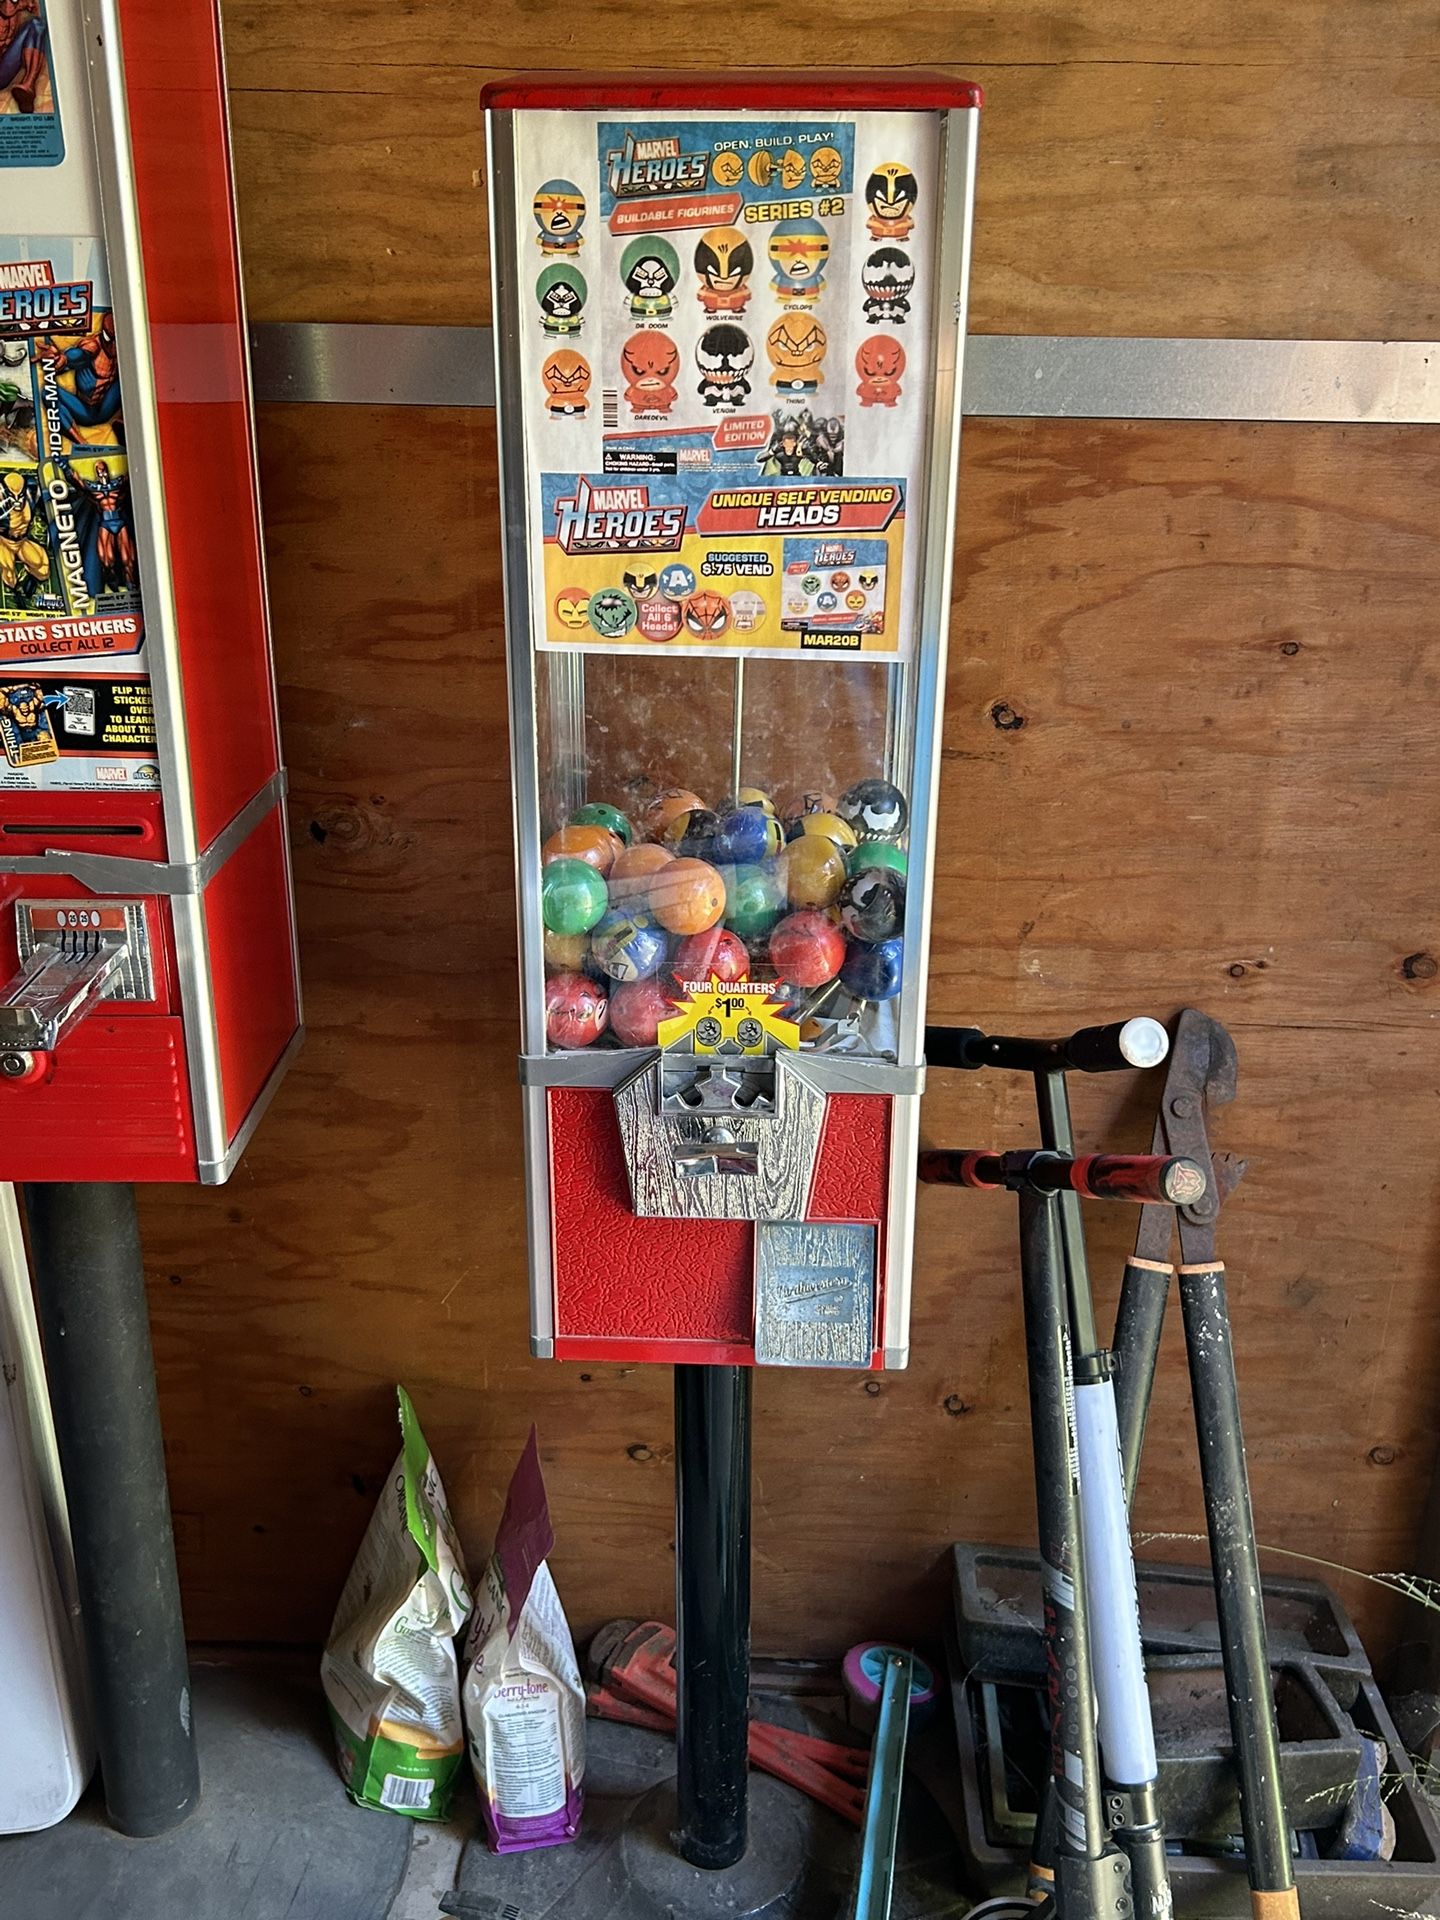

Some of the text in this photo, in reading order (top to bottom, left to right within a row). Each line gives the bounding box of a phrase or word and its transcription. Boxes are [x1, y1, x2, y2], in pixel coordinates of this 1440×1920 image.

[798, 132, 834, 144] PLAY!
[636, 140, 678, 160] MARVEL
[609, 132, 706, 190] HEROES
[617, 203, 735, 224] BUILDABLE FIGURINES
[745, 198, 844, 222] SERIES #2
[0, 264, 51, 290] MARVEL
[0, 285, 88, 320] EROES
[723, 420, 765, 432] LIMITED
[724, 431, 766, 443] EDITION
[619, 454, 657, 462] WARNING:
[680, 449, 711, 462] MARVEL
[593, 489, 645, 510] MARVEL
[712, 488, 893, 508] UNIQUE SELF VENDING
[559, 479, 682, 548] HEROES
[758, 504, 840, 527] HEADS
[49, 479, 90, 610] MAGNETO
[708, 553, 768, 563] SUGGESTED
[736, 563, 773, 576] VEND
[641, 603, 678, 613] Collect
[647, 613, 671, 622] All 6
[51, 617, 137, 640] STICKERS
[642, 621, 678, 631] Heads!
[20, 637, 115, 655] COLLECT ALL 12
[804, 634, 860, 647] MAR20B
[112, 686, 133, 695] FLIP
[110, 715, 122, 724] TO
[105, 725, 136, 734] ABOUT
[97, 768, 127, 780] MARVEL
[683, 981, 776, 995] FOUR QUARTERS
